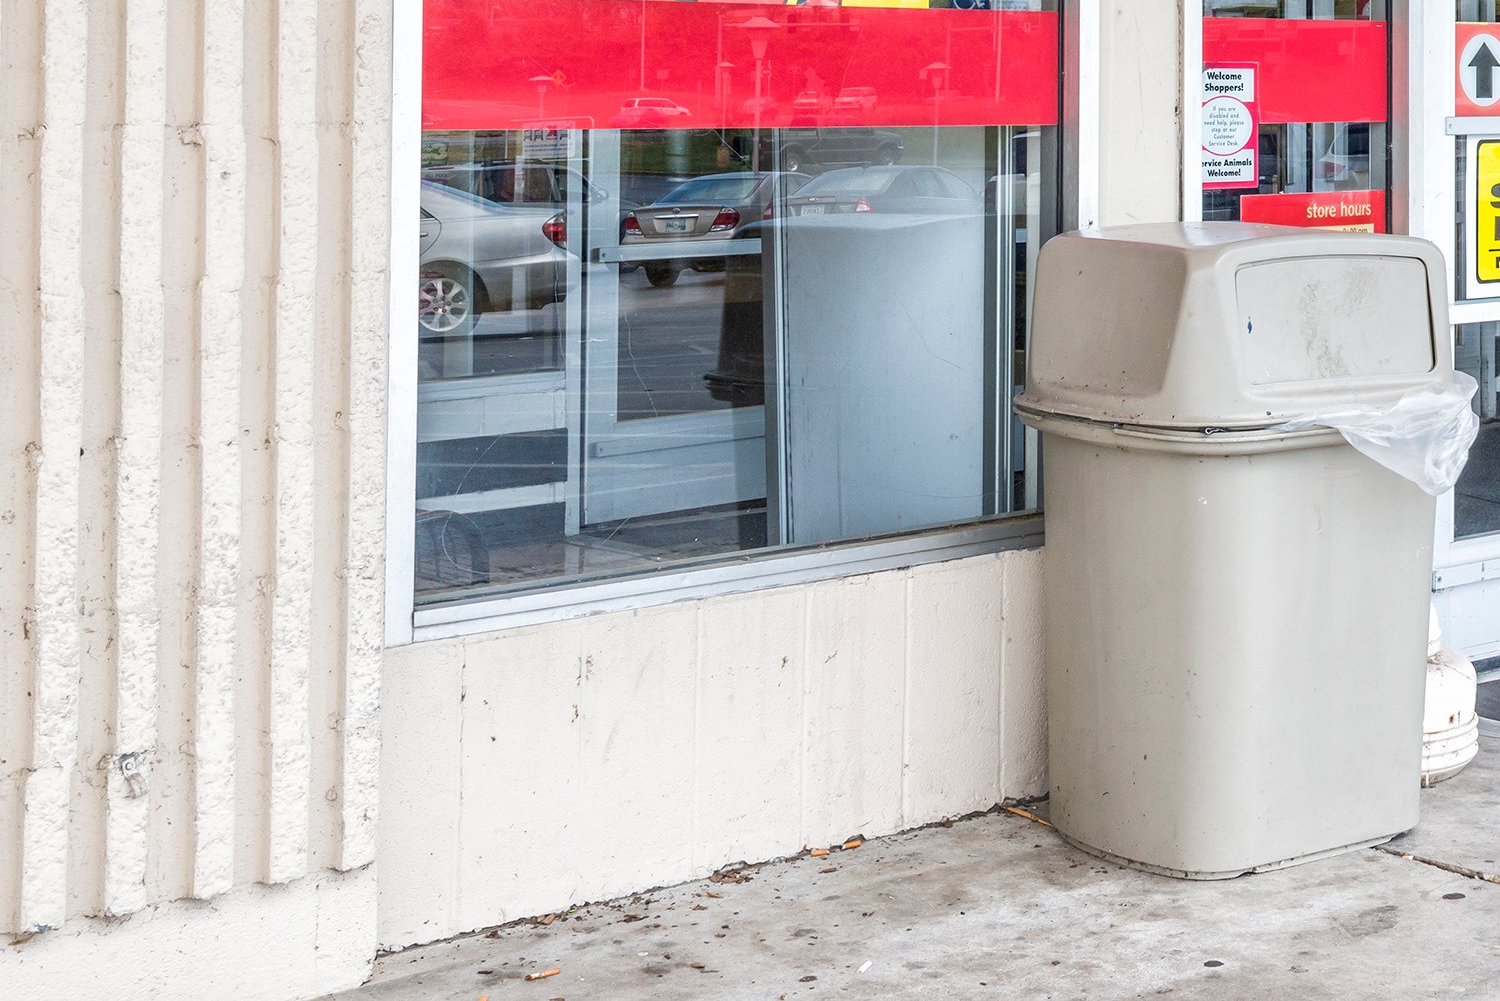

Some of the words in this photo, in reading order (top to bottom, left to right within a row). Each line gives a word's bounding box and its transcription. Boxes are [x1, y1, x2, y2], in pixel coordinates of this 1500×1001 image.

[1207, 71, 1242, 80] Welcome
[1204, 83, 1244, 93] Shoppers!
[1218, 106, 1227, 115] you
[1202, 159, 1222, 167] ervice
[1223, 158, 1252, 167] Animals
[1207, 169, 1241, 177] Welcome!
[1306, 202, 1337, 219] store
[1340, 201, 1371, 217] hours
